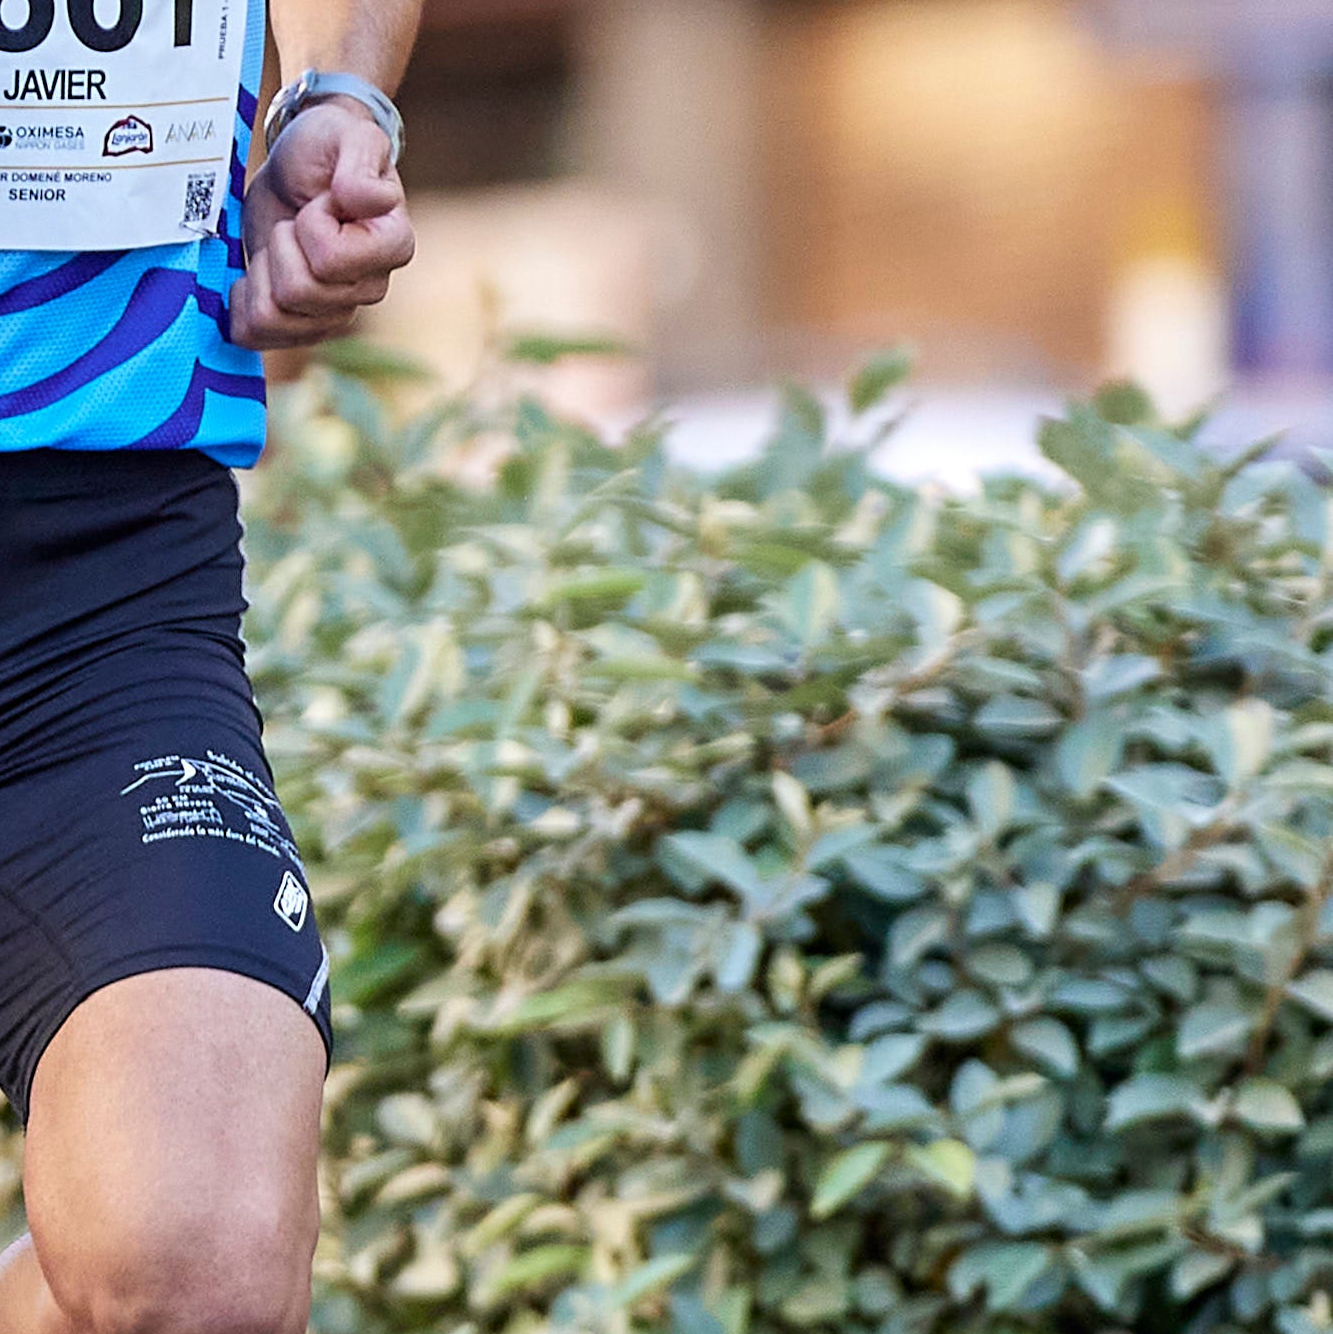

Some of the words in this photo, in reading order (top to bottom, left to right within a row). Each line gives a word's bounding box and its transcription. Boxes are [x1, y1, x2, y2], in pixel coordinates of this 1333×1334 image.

[3, 69, 107, 101] JAVIER
[16, 126, 84, 139] OXIMESA
[64, 172, 112, 182] MORENO
[8, 188, 66, 201] SENIOR
